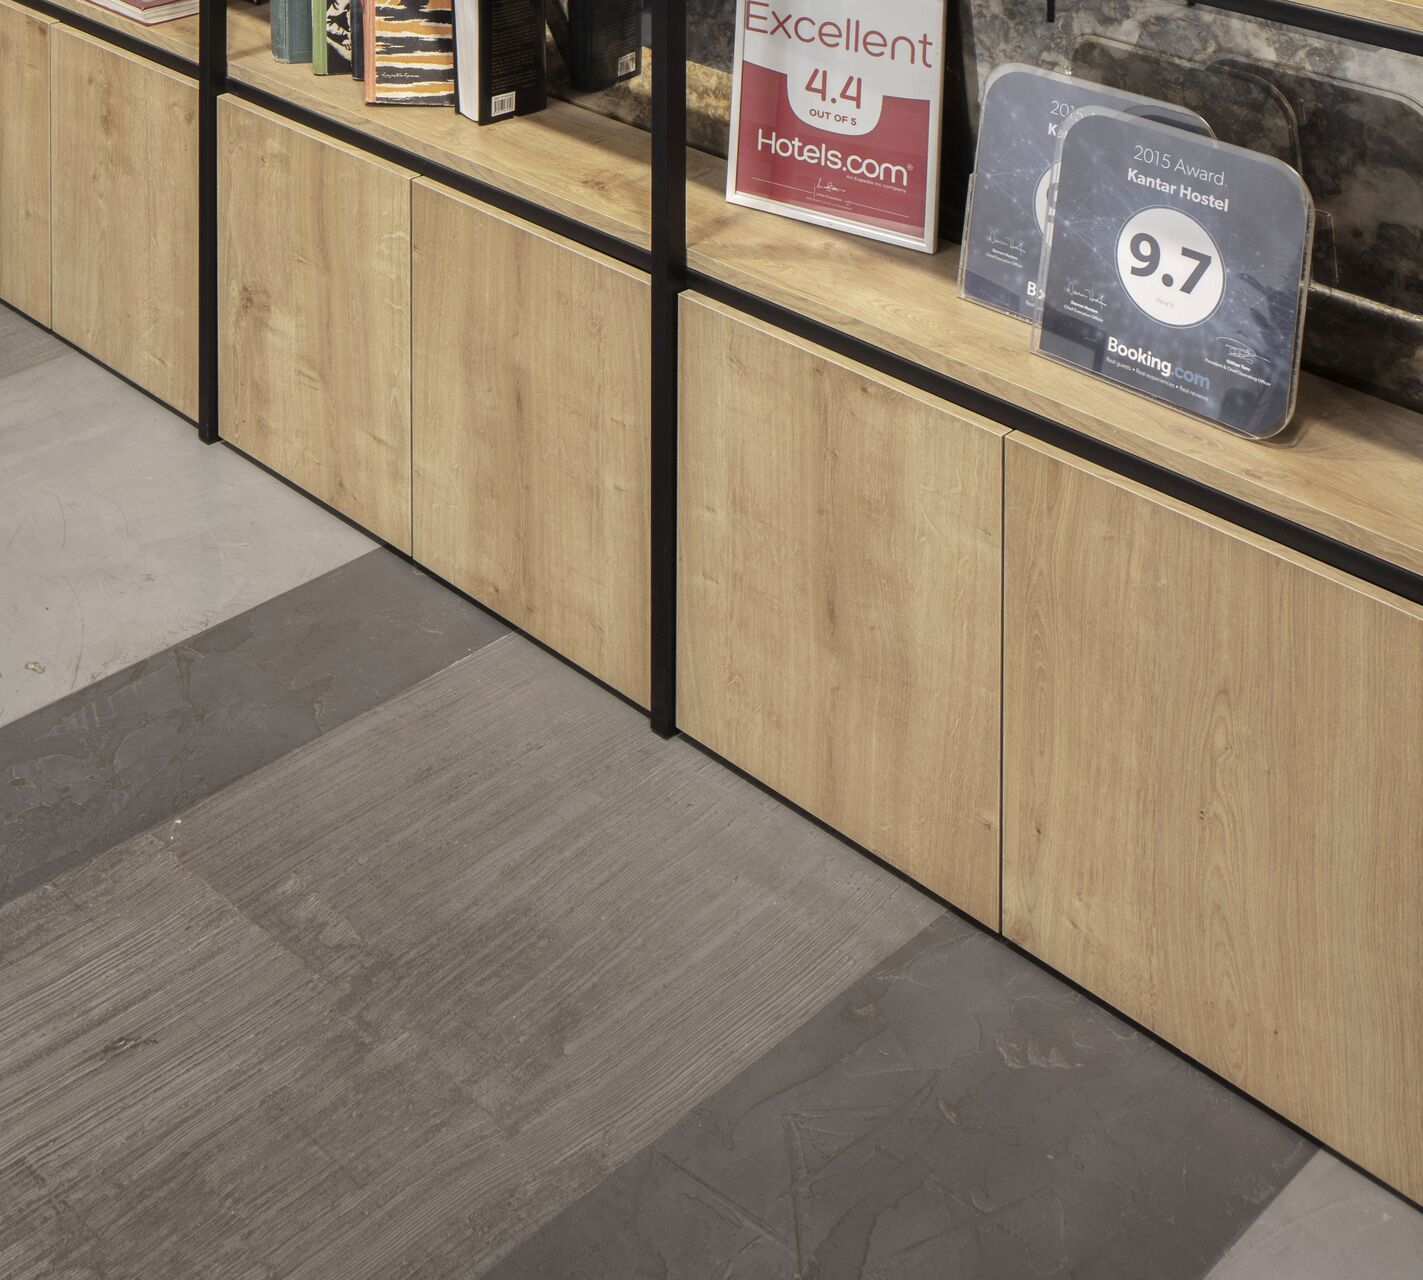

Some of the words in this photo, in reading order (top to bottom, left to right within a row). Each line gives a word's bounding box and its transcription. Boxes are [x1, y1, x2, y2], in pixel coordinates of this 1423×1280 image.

[745, 0, 933, 68] Excellent
[805, 68, 862, 109] 4.4
[809, 108, 832, 120] OUT
[834, 114, 848, 124] OF
[850, 117, 857, 126] 5
[1133, 145, 1171, 170] 2015
[1174, 158, 1225, 187] Award
[1127, 168, 1177, 195] Kantar
[1179, 184, 1229, 212] Hostel
[1129, 232, 1212, 295] 9.7
[1106, 356, 1116, 365] Real
[1116, 361, 1132, 372] guests
[1135, 367, 1146, 377] Real
[1189, 389, 1209, 402] reviews
[1107, 336, 1210, 390] Booking.com
